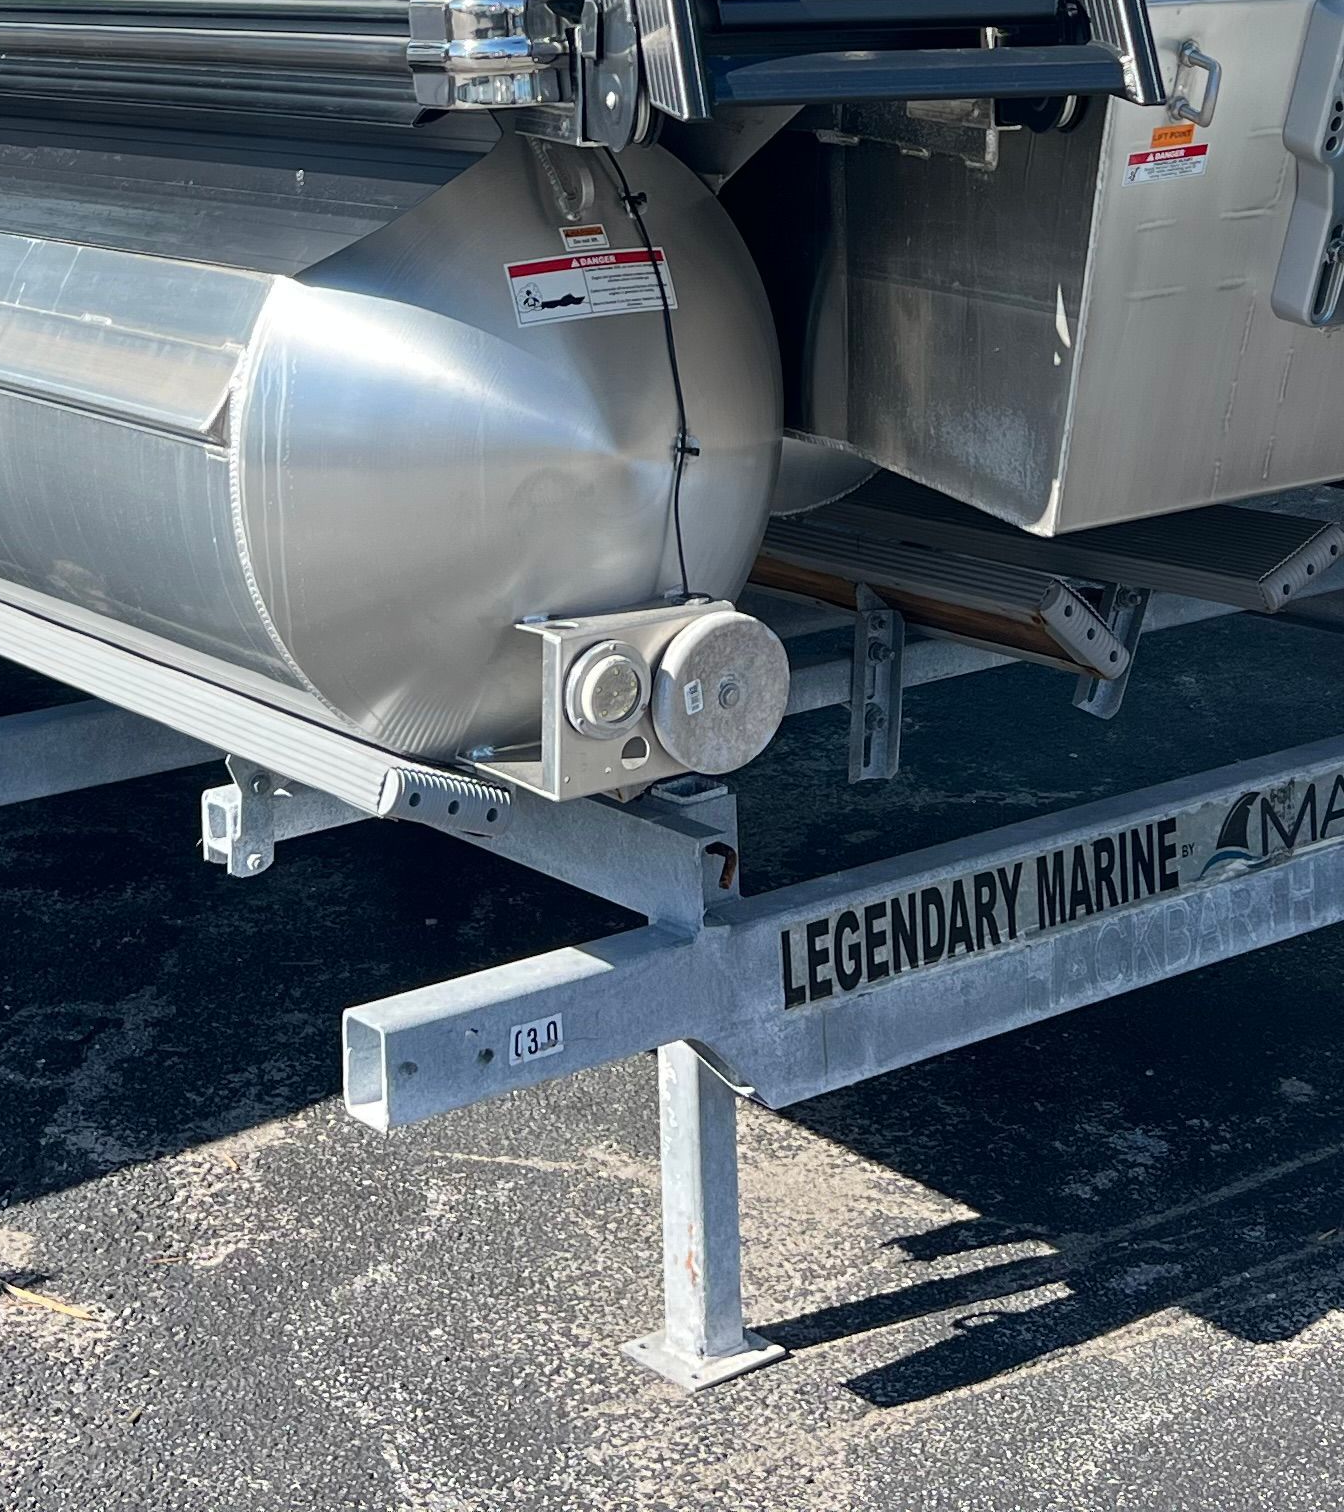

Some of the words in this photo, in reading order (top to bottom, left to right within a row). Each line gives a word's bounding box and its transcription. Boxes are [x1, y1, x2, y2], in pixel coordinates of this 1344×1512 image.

[1154, 149, 1186, 161] DANGER
[579, 255, 617, 267] DANGER
[781, 862, 1023, 1011] LEGENDARY
[1036, 817, 1180, 931] MARINE
[1181, 842, 1196, 859] BY
